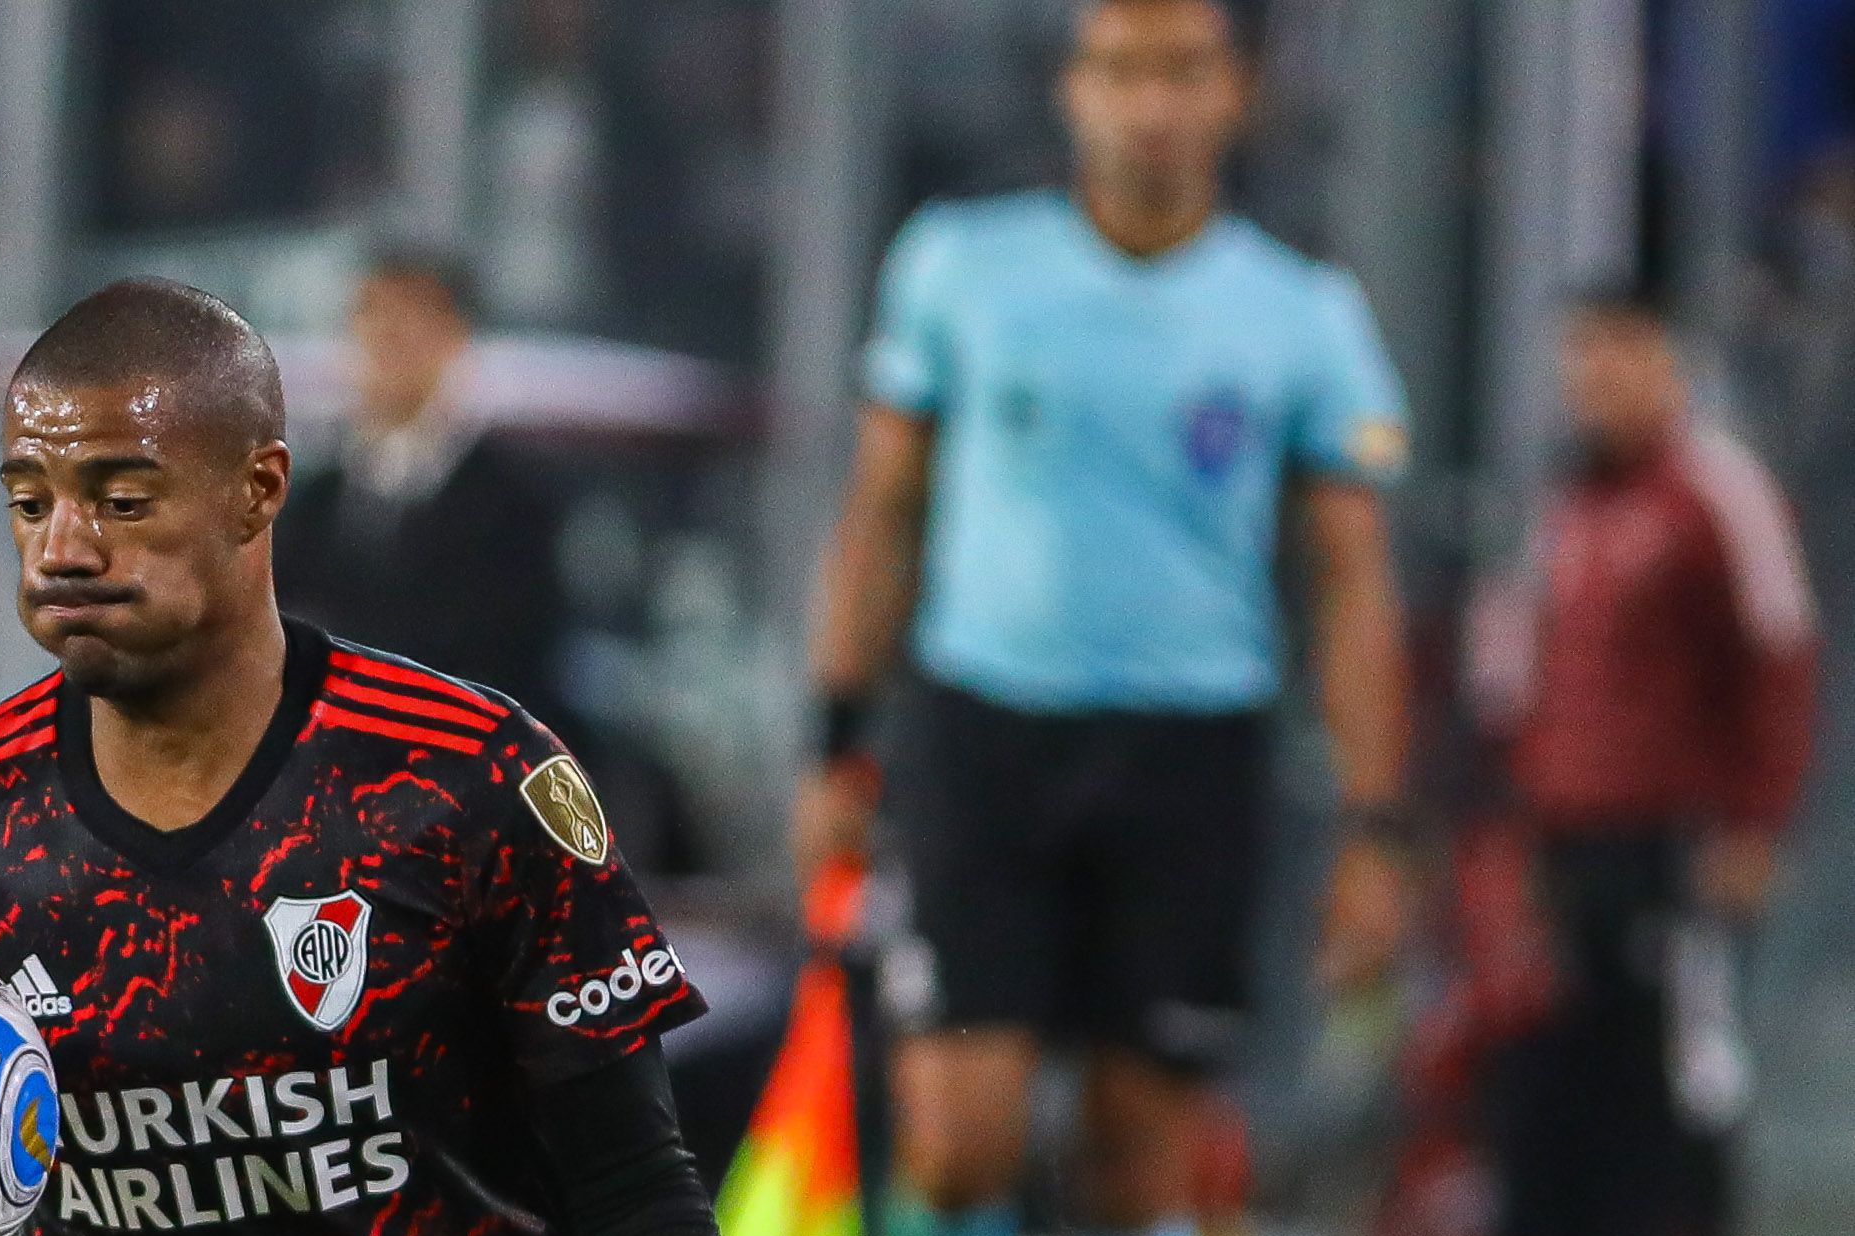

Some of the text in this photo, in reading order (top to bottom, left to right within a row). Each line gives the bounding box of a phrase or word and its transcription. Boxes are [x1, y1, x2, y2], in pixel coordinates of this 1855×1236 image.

[582, 825, 598, 852] 4
[57, 1057, 393, 1155] URKISH
[60, 1131, 410, 1230] AIRLINES
